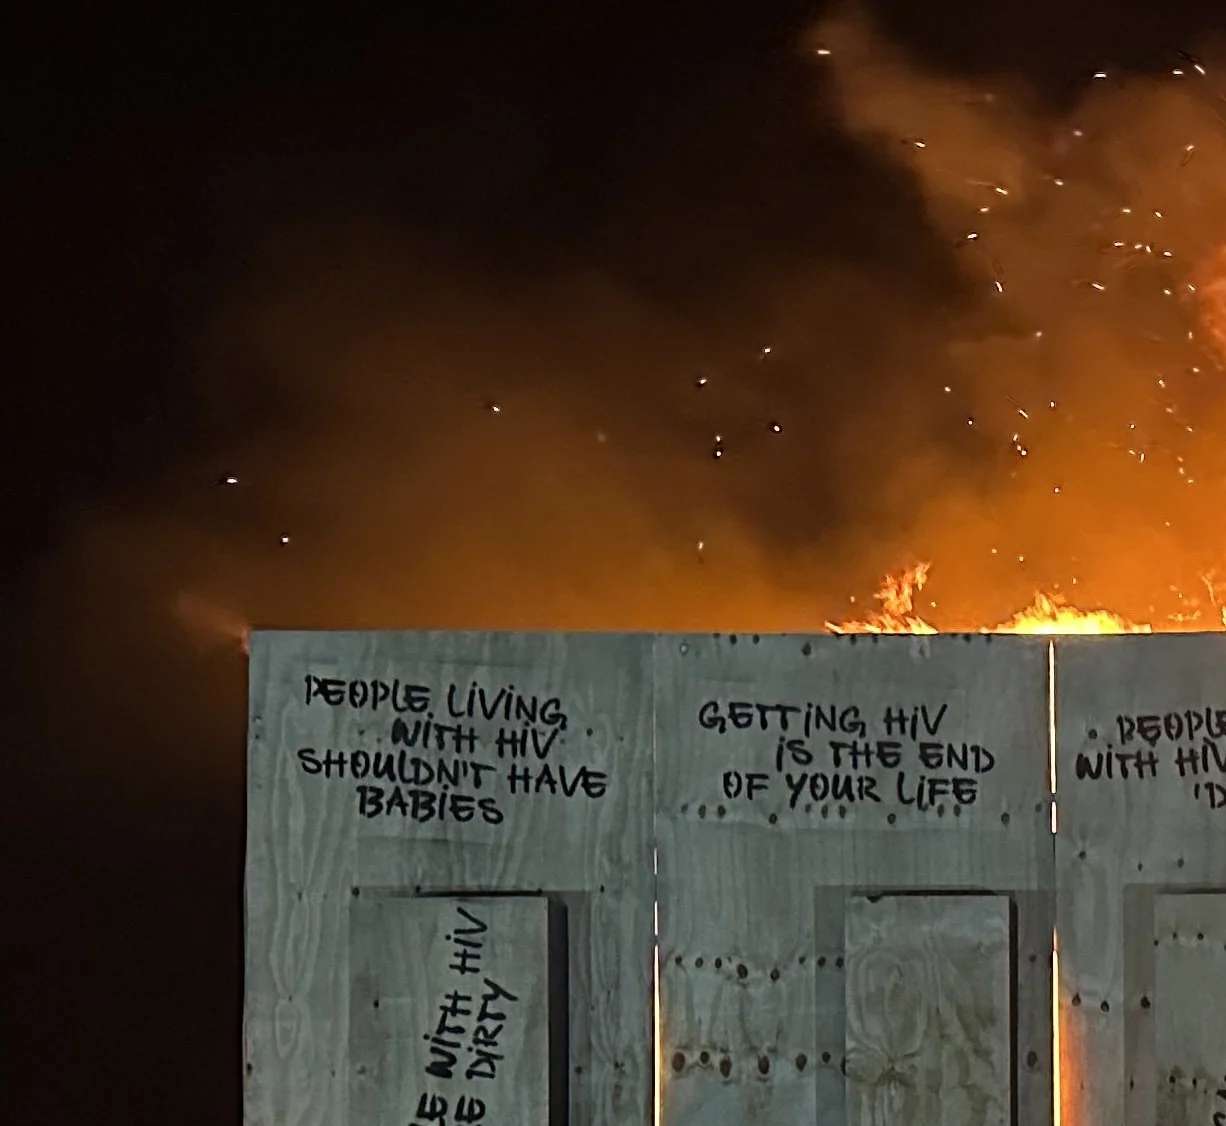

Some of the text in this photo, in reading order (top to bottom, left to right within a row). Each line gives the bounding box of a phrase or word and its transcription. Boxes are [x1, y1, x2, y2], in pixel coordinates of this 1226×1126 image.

[304, 674, 431, 712] PEOPLE
[297, 748, 608, 798] SHOULDN'T HAVE
[829, 740, 901, 770] THE
[919, 743, 995, 773] END
[723, 771, 769, 800] OF
[786, 772, 881, 809] YOUR
